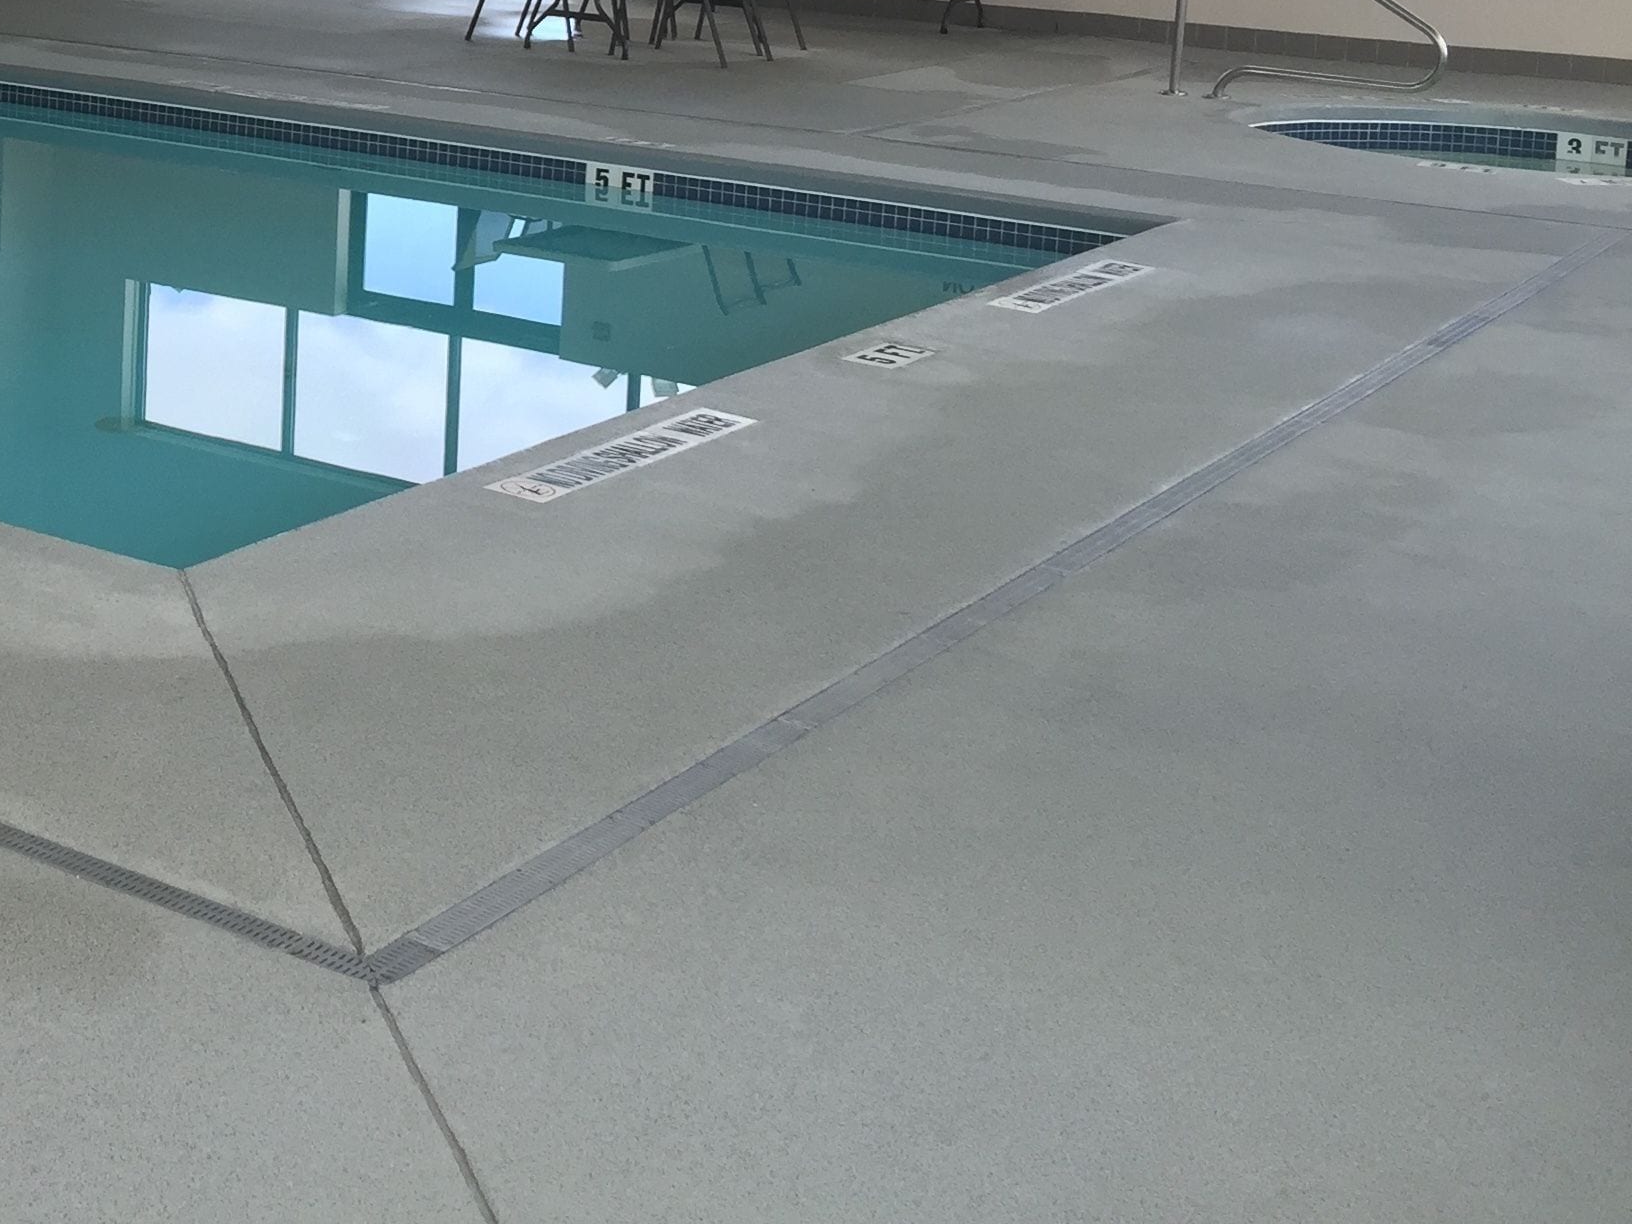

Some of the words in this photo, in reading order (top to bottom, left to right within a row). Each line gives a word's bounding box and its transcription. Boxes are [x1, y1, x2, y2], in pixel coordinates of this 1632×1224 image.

[595, 168, 609, 187] 5
[856, 354, 897, 364] 5
[873, 345, 926, 359] FT
[590, 431, 689, 465] SHALLOW
[660, 412, 741, 438] WATER
